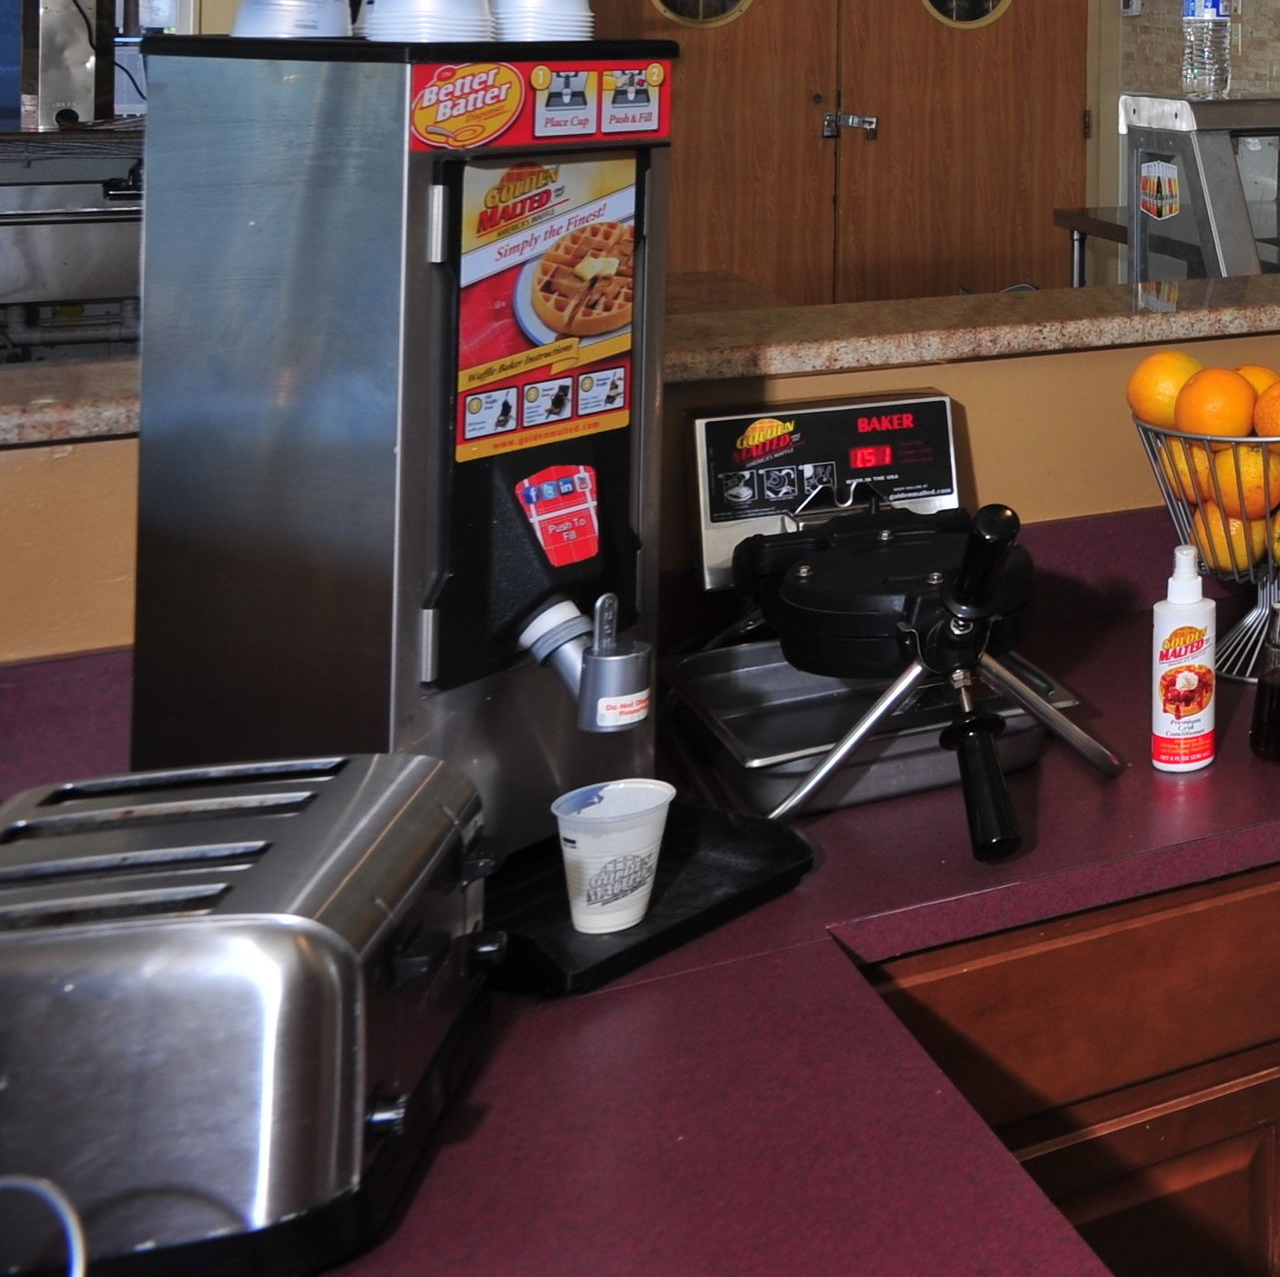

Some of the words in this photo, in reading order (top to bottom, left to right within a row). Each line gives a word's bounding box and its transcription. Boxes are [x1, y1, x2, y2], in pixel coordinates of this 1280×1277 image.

[421, 67, 499, 109] Better
[436, 82, 512, 123] Batter
[544, 116, 569, 128] Place
[570, 115, 590, 129] Cup
[608, 113, 630, 124] Push
[484, 165, 560, 209] GOLDEN
[477, 188, 553, 234] MALTED
[495, 234, 541, 262] Simply
[543, 225, 562, 241] the
[566, 204, 607, 232] Finest!
[857, 413, 915, 433] BAKER
[548, 522, 572, 534] Push
[1159, 638, 1205, 662] MALTED
